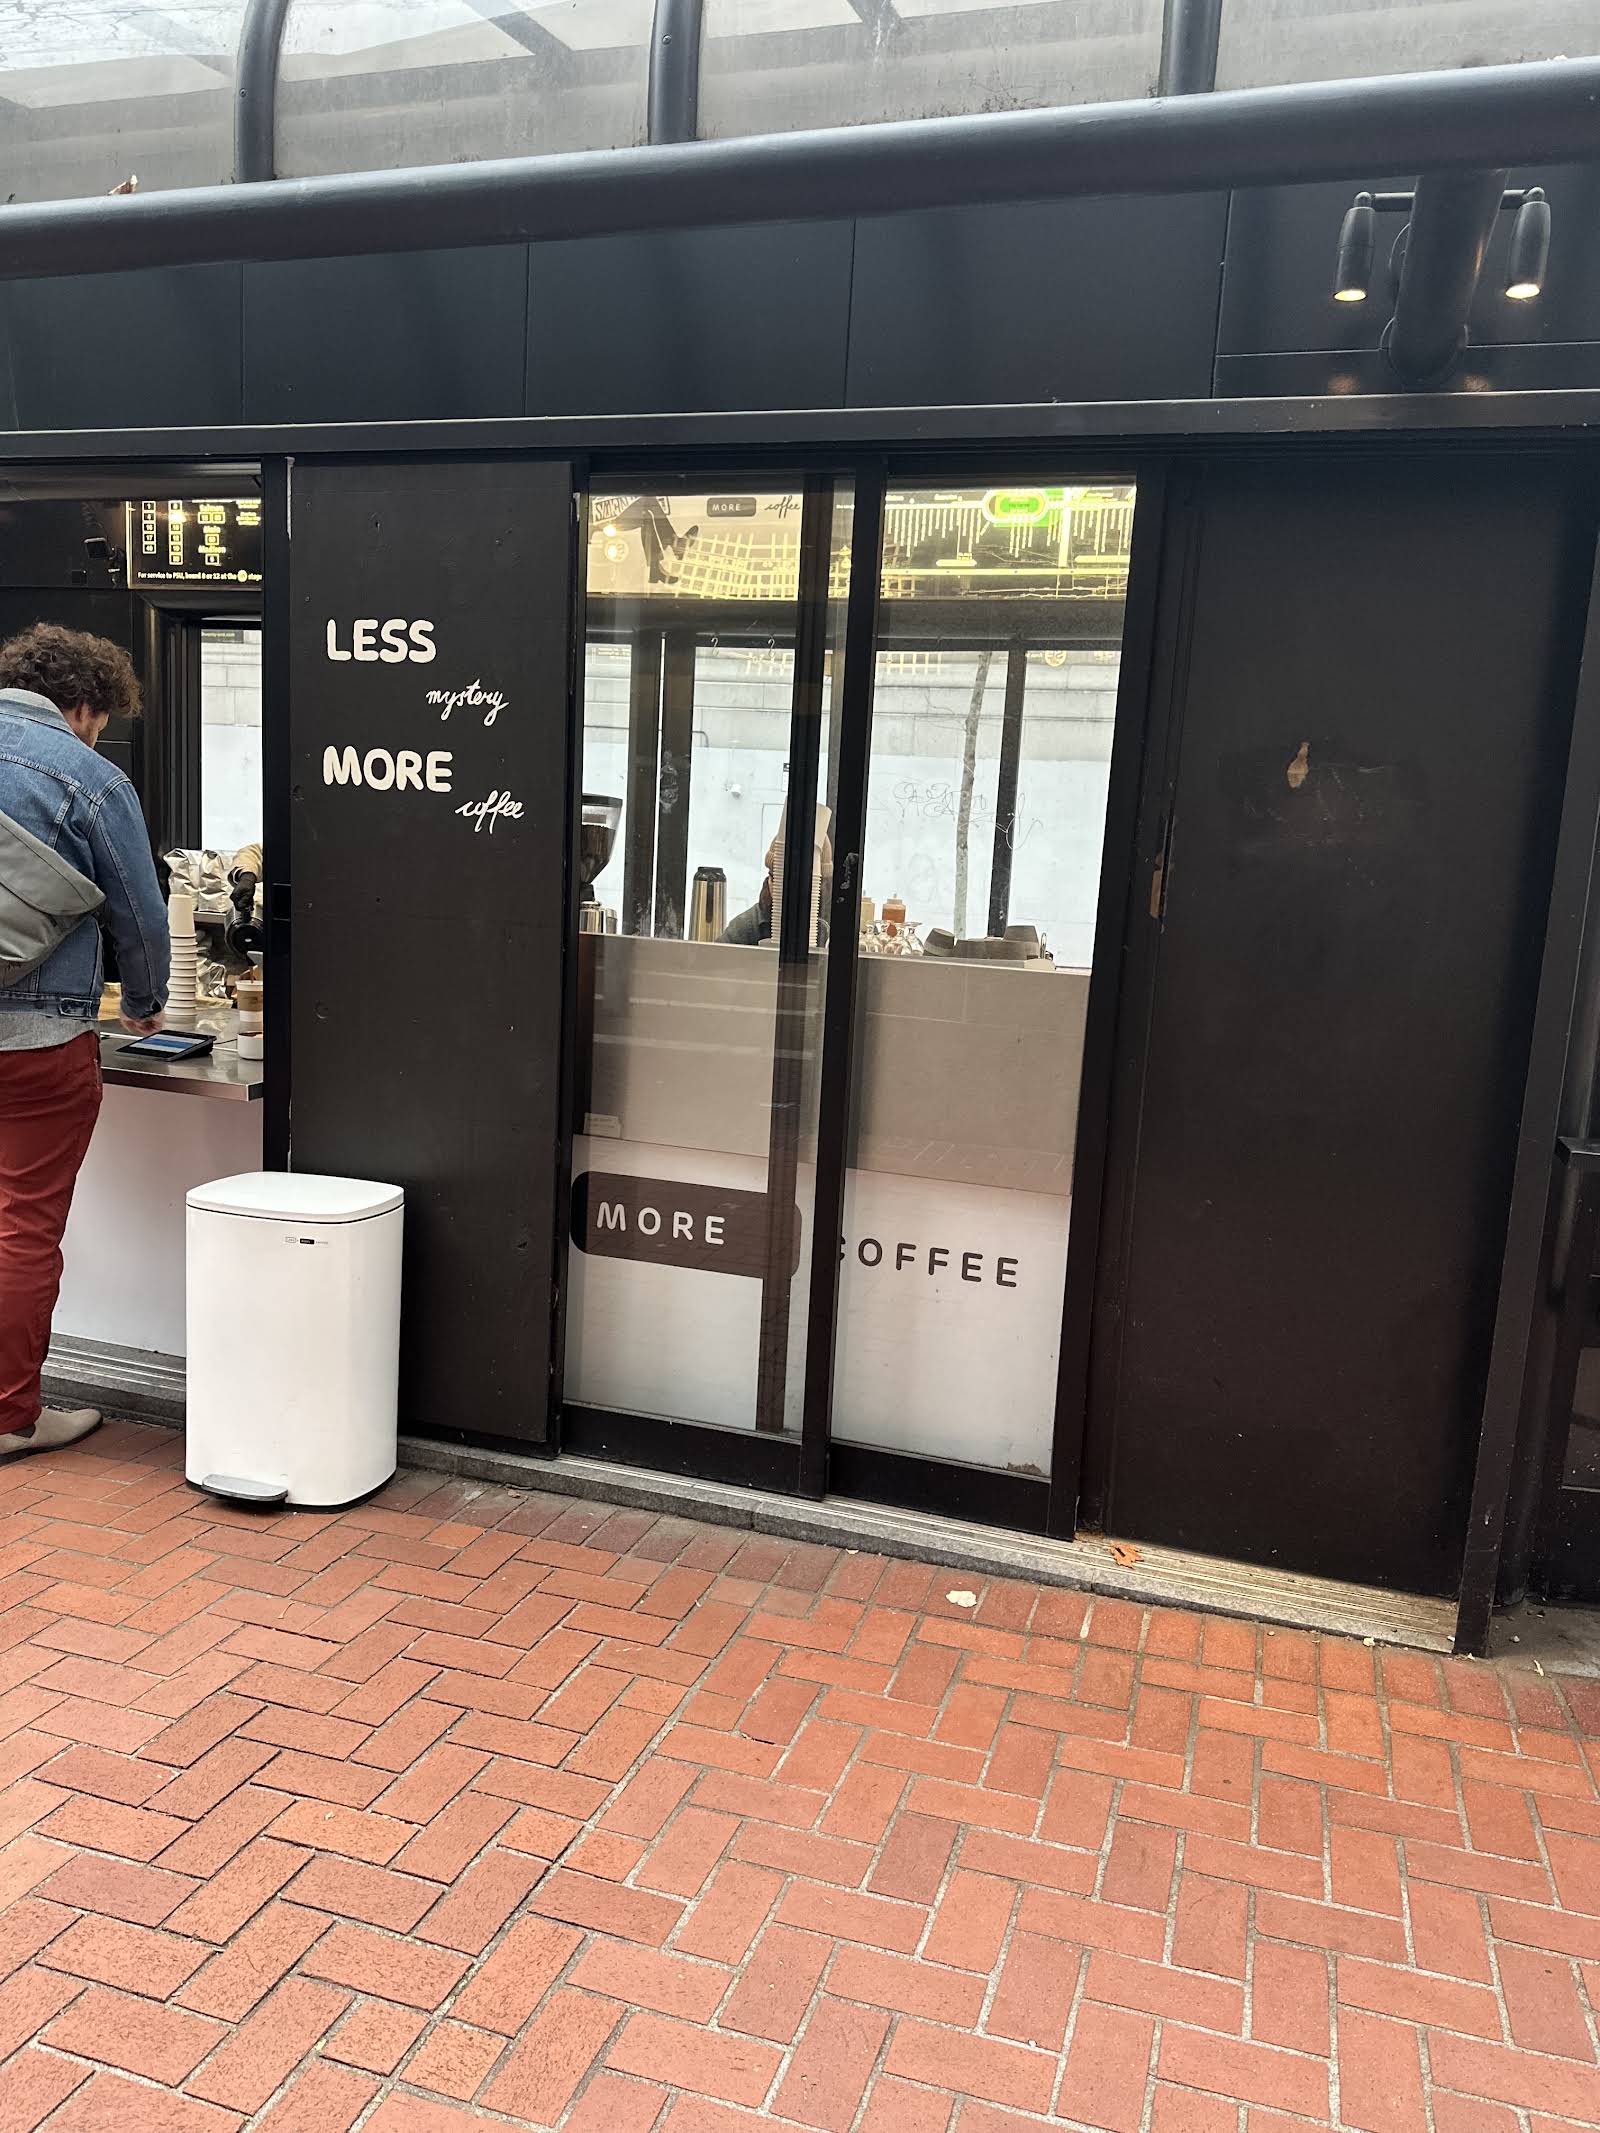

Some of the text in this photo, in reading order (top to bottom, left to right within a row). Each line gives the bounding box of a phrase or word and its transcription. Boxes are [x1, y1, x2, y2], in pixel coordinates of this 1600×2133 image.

[711, 494, 801, 519] MORE coffee
[327, 618, 437, 663] LESS
[426, 678, 509, 726] mystery
[323, 746, 453, 793] MORE
[455, 790, 525, 834] coffee
[596, 1201, 1019, 1288] MORE OFFEE
